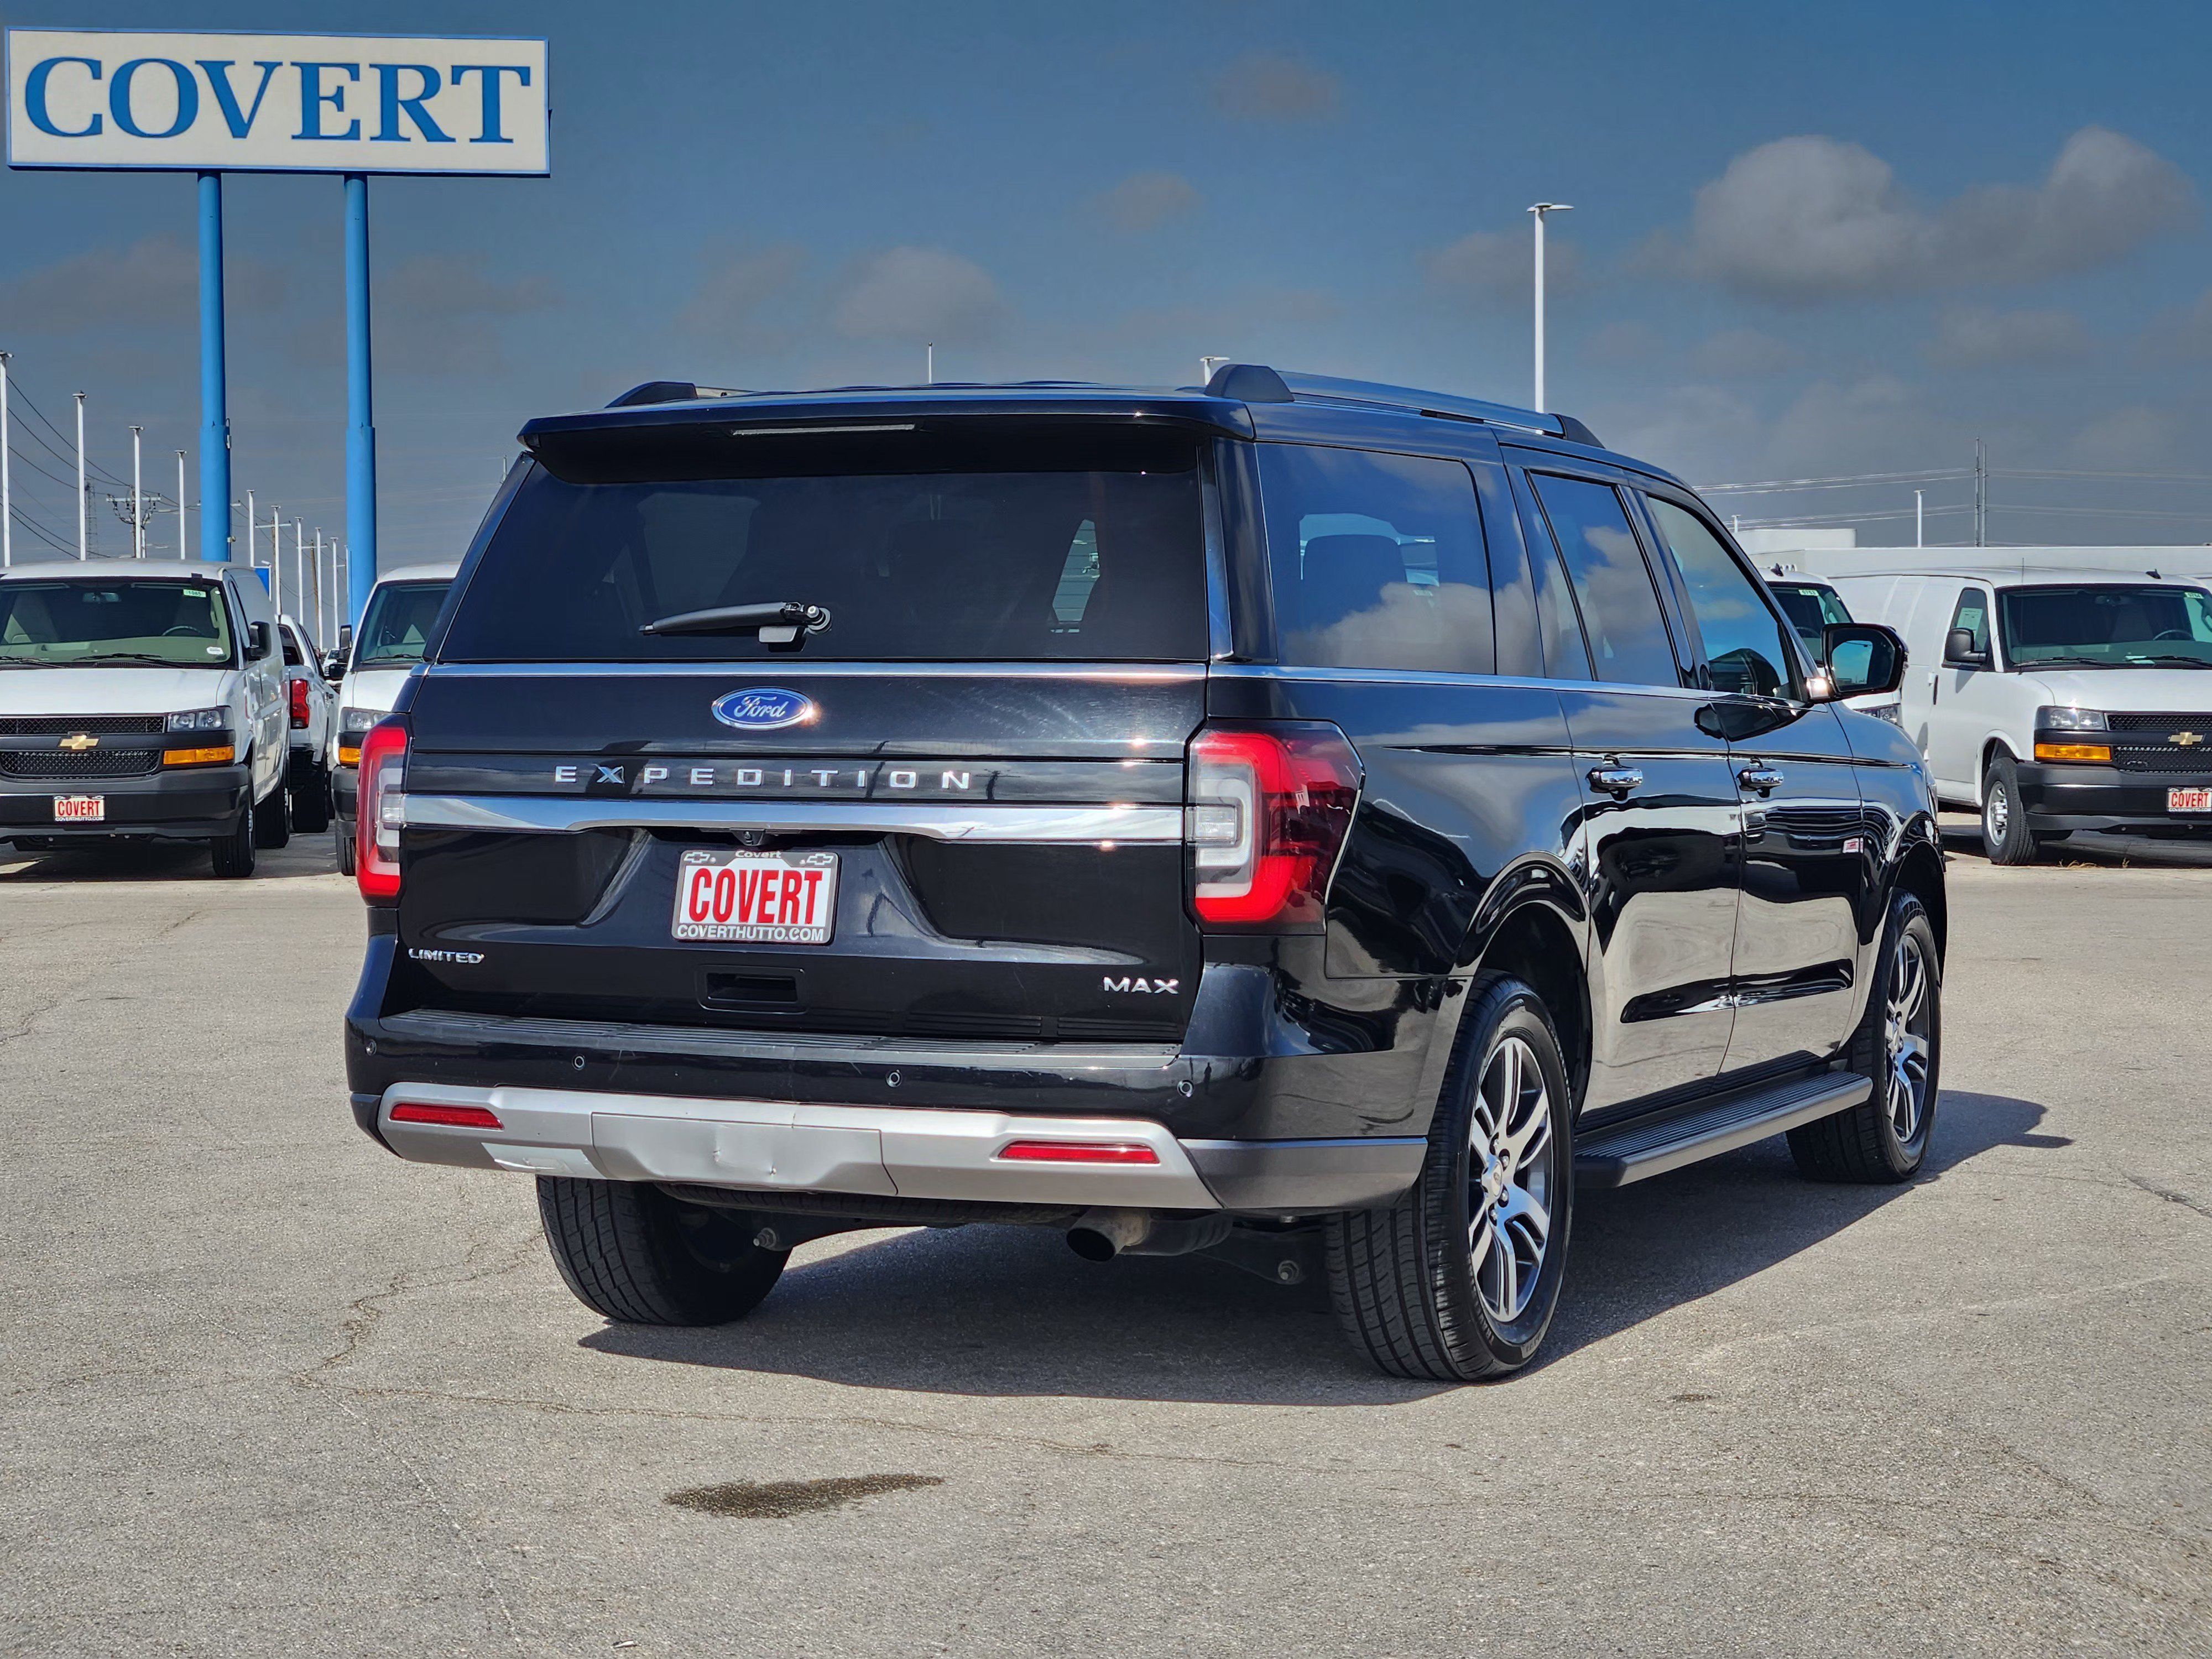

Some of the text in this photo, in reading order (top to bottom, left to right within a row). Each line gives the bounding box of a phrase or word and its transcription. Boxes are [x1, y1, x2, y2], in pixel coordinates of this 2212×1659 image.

[25, 56, 530, 143] COVERT
[734, 695, 789, 717] Ford
[555, 765, 970, 790] EXPEDITION
[58, 800, 101, 816] COVERT
[2172, 792, 2209, 807] COVERT
[735, 850, 782, 858] Covert
[688, 868, 823, 925] COVERT
[677, 924, 824, 942] COVERTHUTTO.COM
[408, 948, 485, 964] LIMITED
[1103, 976, 1180, 994] MAX
